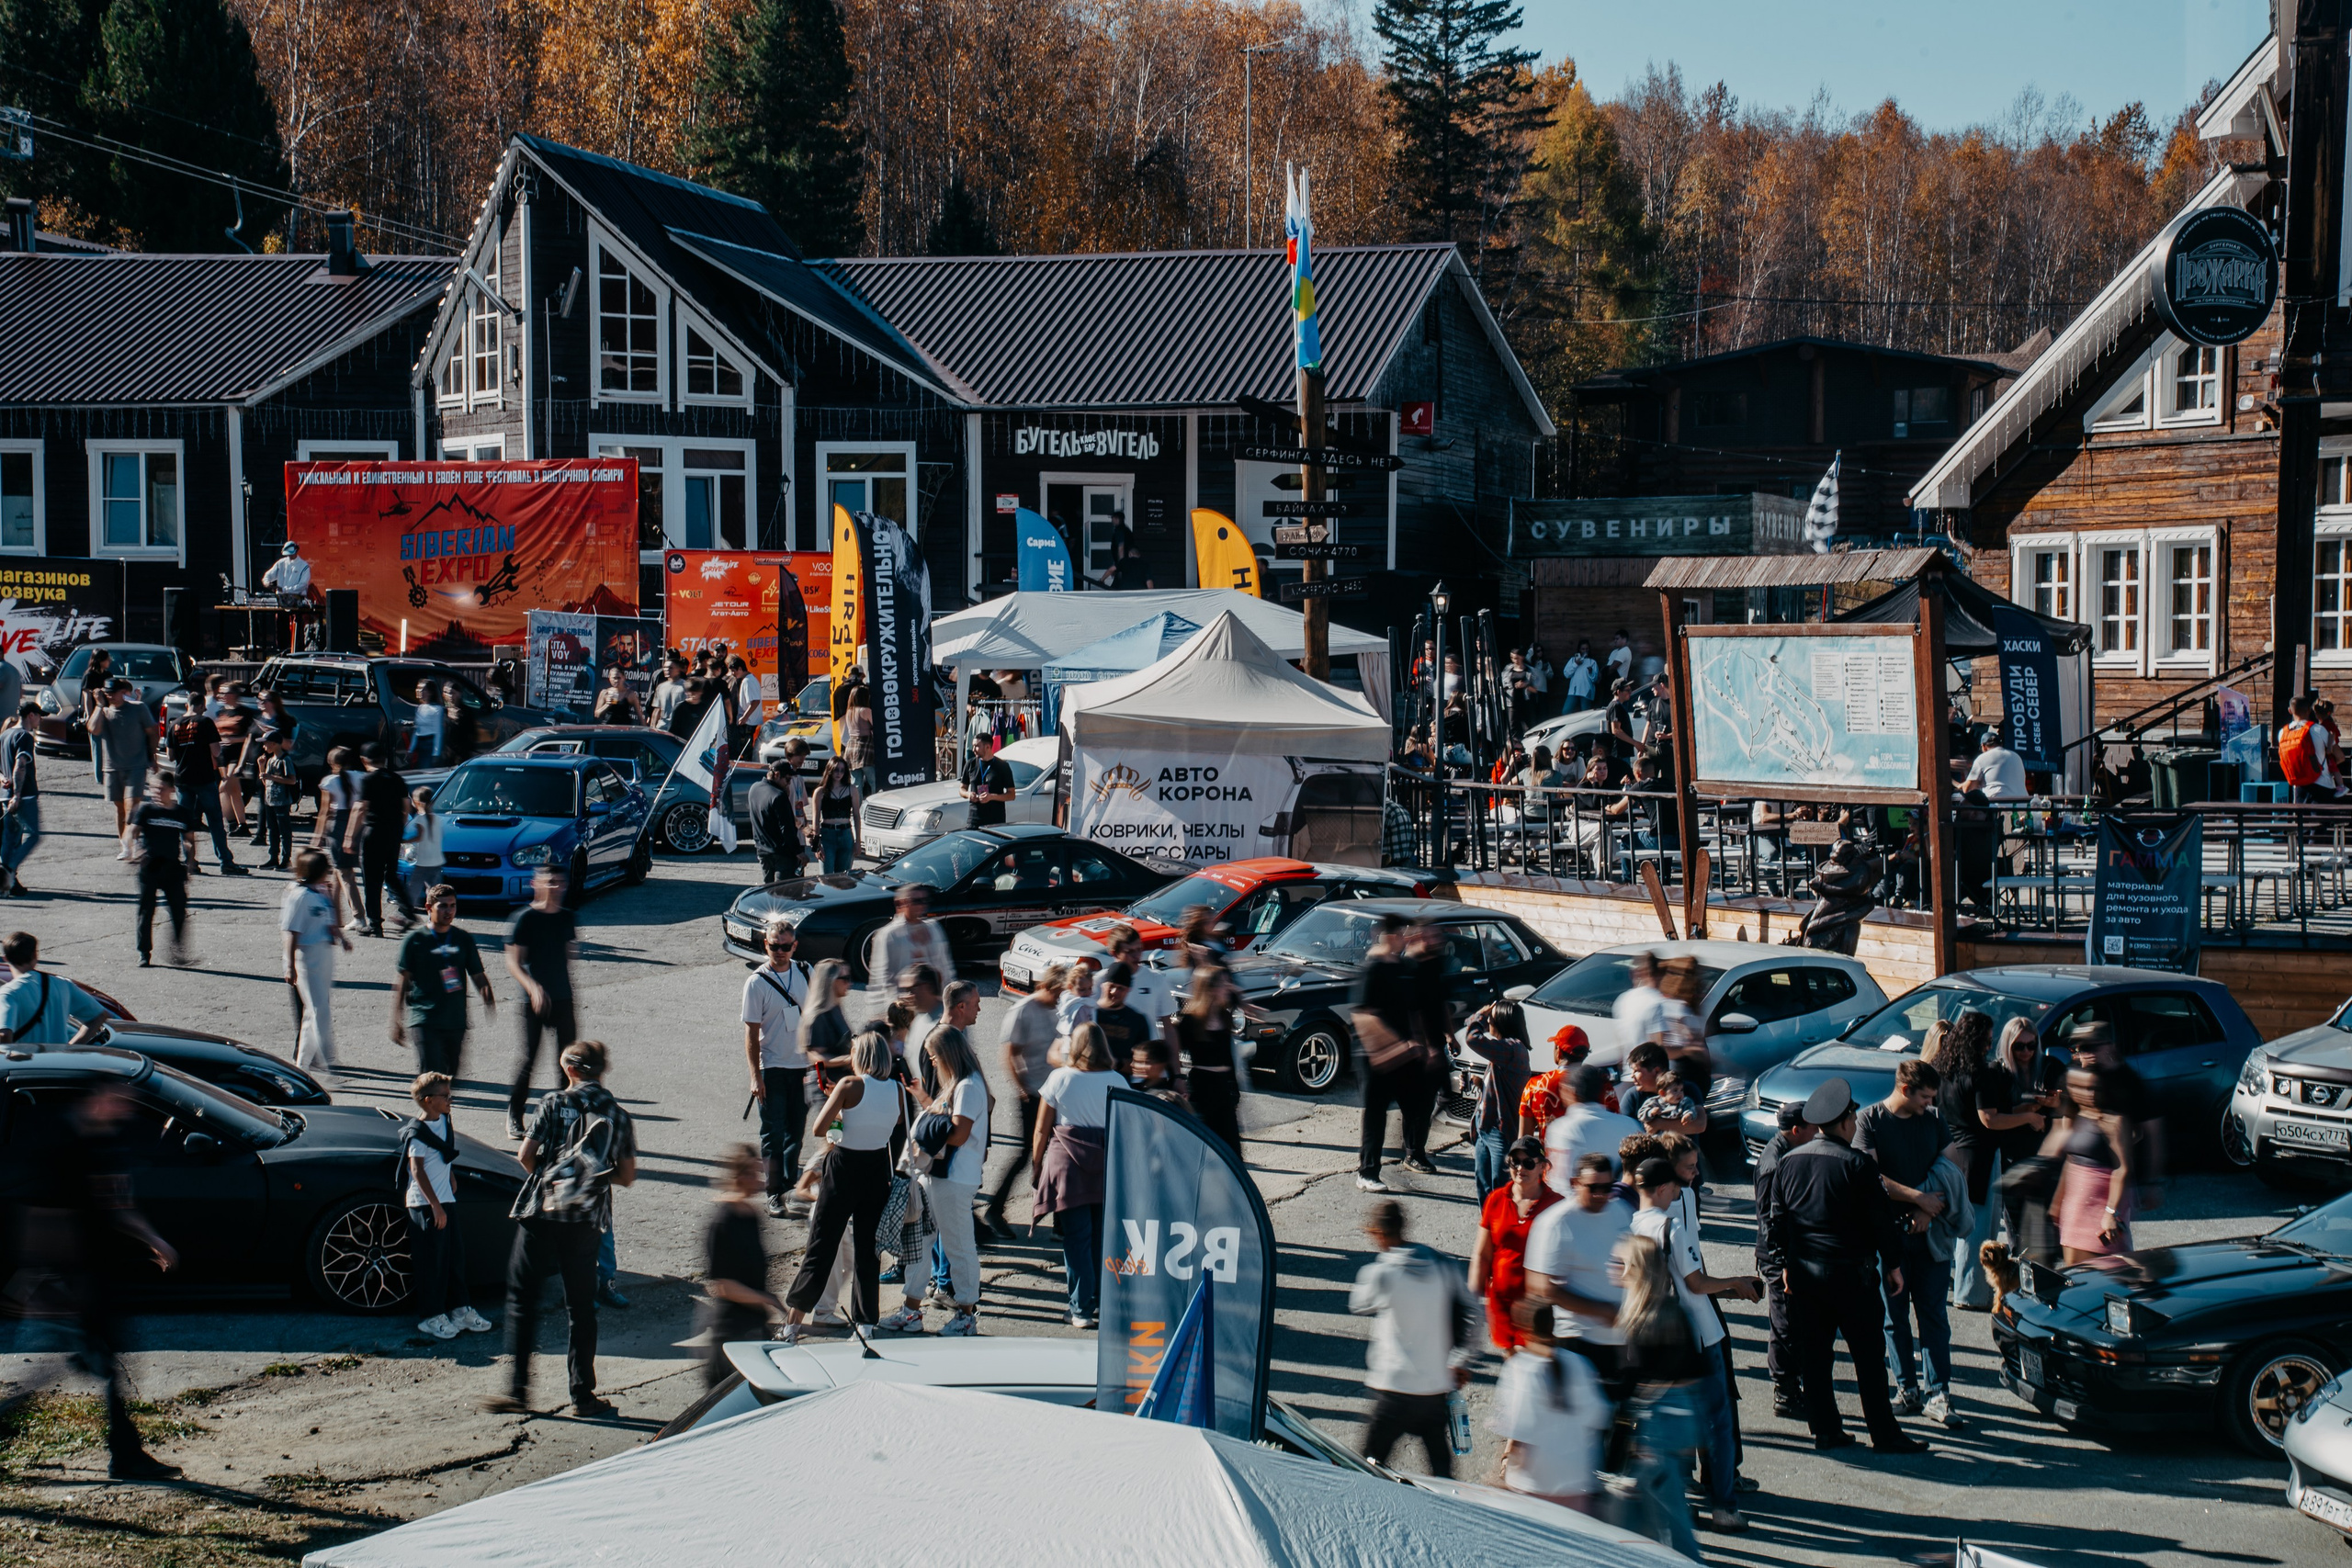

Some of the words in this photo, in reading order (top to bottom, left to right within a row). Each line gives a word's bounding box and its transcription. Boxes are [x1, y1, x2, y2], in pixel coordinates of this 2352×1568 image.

[2175, 252, 2268, 305] ПРОЖАРКА
[1015, 426, 1082, 457] БУГЕЛЬ
[1080, 434, 1097, 445] КАФЕ
[1084, 443, 1096, 453] БАР
[1245, 446, 1311, 461] СЕРФИНГА
[1321, 451, 1363, 465] ЗДЕСЬ
[1371, 457, 1393, 468] НЕТ
[298, 469, 351, 485] УНИКАЛЬНЫЙ
[354, 470, 359, 484] И
[362, 469, 424, 485] ЕДИНСТВЕННЫЙ
[427, 470, 433, 484] В
[463, 470, 483, 484] РОДЕ
[486, 469, 532, 484] ФЕСТИВАЛЬ
[535, 469, 539, 483] В
[542, 468, 590, 483] ВОСТОЧНОЙ
[592, 468, 624, 482] СИБИРИ
[1275, 502, 1325, 513] БАЙКАЛ
[1531, 515, 1731, 540] СУВЕНИРЫ
[401, 525, 516, 560] SIBERIAN
[421, 555, 491, 585] EXPO
[0, 570, 91, 586] агазинов
[0, 585, 66, 604] озвука
[678, 590, 702, 598] VOLT
[809, 605, 831, 614] LikeSt
[537, 626, 555, 635] DRIFT
[566, 627, 593, 637] SIBERIA
[539, 640, 566, 649] NKITA
[746, 636, 778, 649] SIBER
[872, 529, 903, 759] ГОЛОВОКРУЖИТЕЛЬНО
[2004, 640, 2041, 652] ХАСКИ
[754, 647, 778, 659] EXP
[808, 649, 831, 659] СОБО
[911, 653, 920, 686] крепкая
[2024, 666, 2041, 720] СЕВЕР
[2008, 665, 2027, 751] ПРОБУДИ
[1158, 767, 1219, 782] АВТО
[1159, 786, 1253, 802] КОРОНА
[1090, 823, 1178, 840] КОВРИКИ,
[1182, 823, 1245, 838] ЧЕХЛЫ
[2109, 850, 2190, 868] ГАММА
[2107, 882, 2165, 891] материалы
[2106, 893, 2125, 901] для
[2127, 895, 2179, 903] кузовного
[2105, 904, 2150, 913] ремонта
[2160, 906, 2189, 916] ухода
[2105, 916, 2116, 924] за
[2118, 917, 2142, 925] авто
[1018, 943, 1045, 957] Civic
[2326, 1129, 2346, 1141] 777
